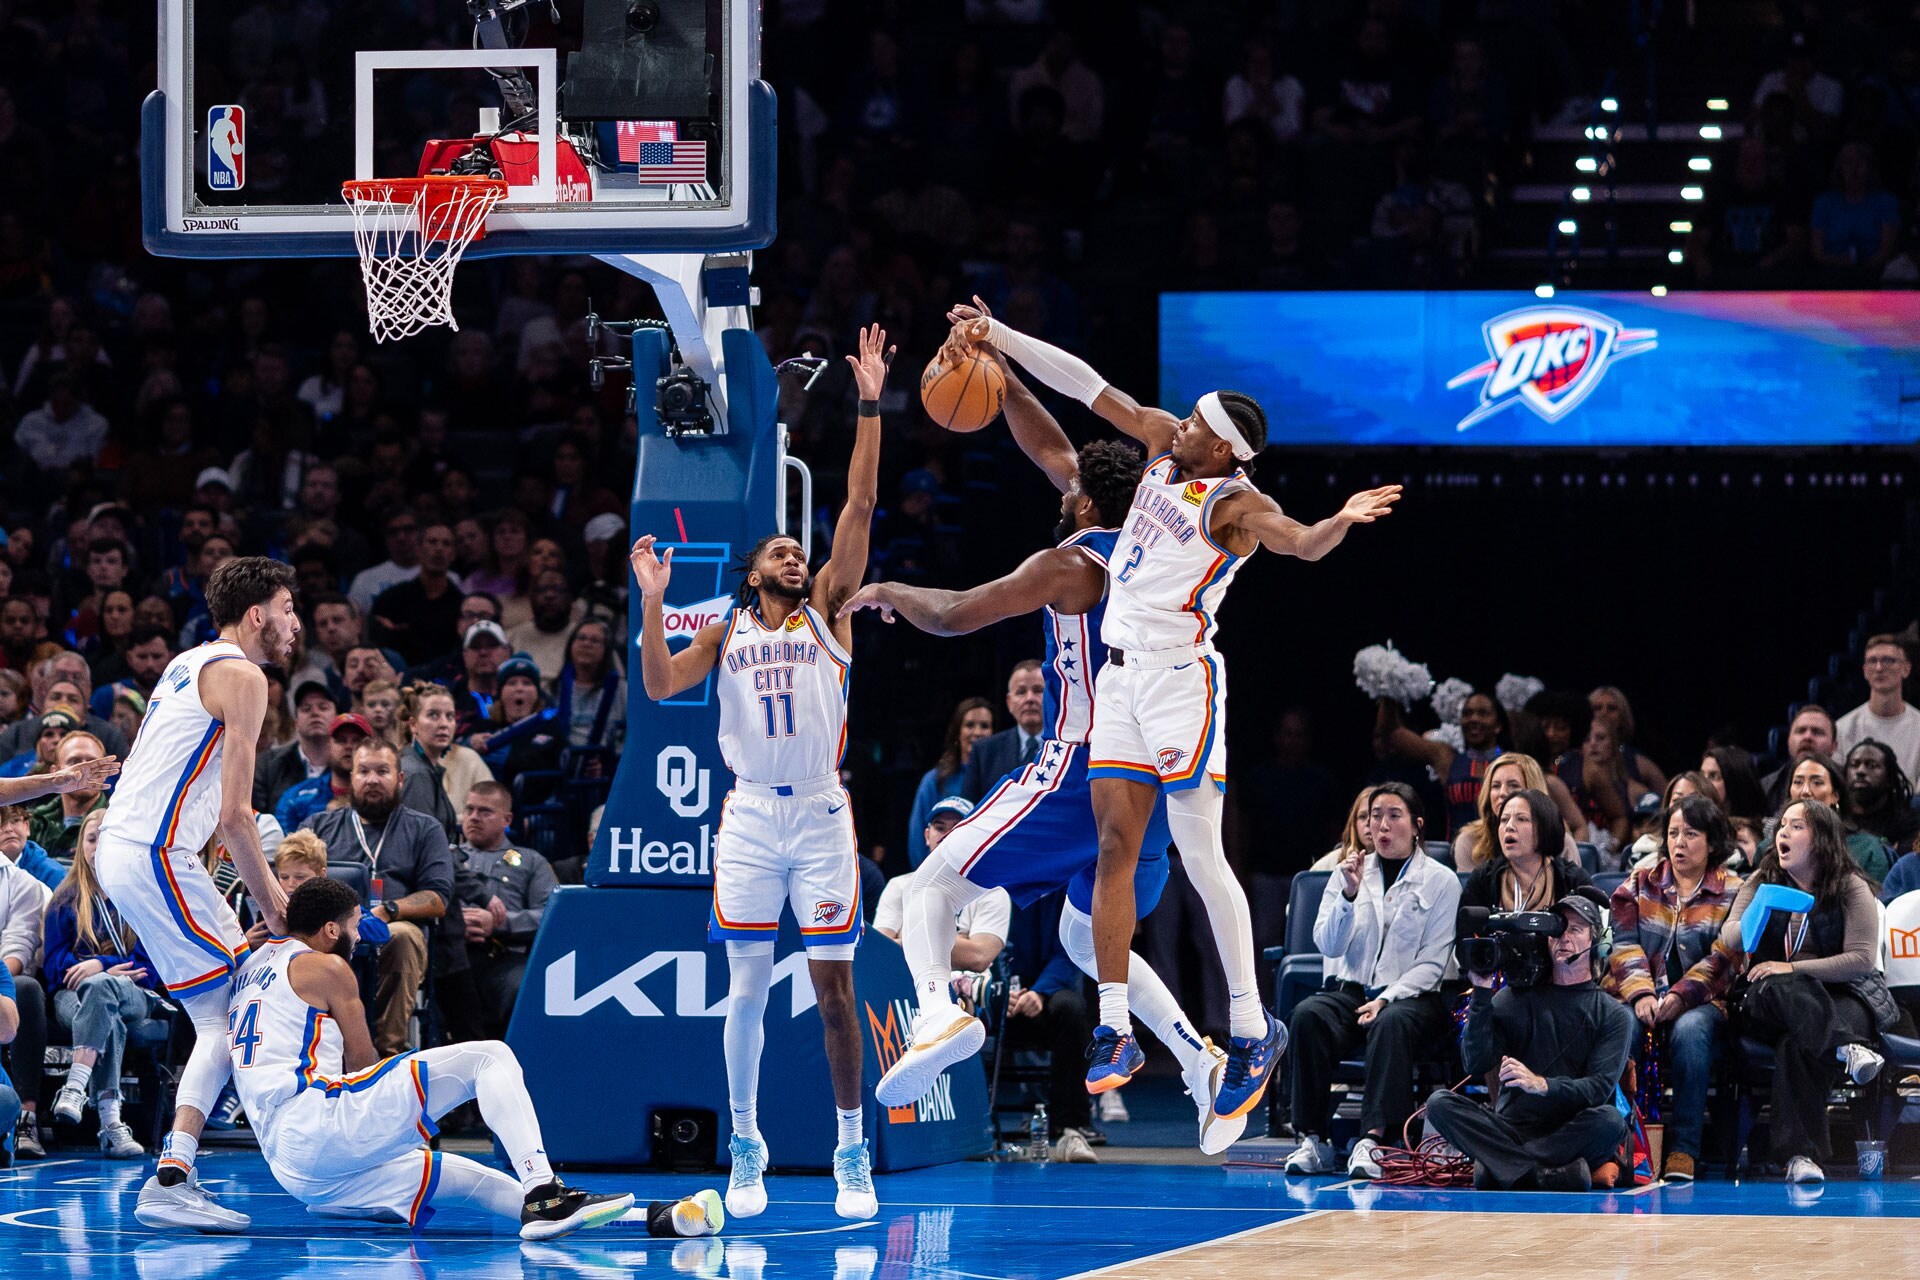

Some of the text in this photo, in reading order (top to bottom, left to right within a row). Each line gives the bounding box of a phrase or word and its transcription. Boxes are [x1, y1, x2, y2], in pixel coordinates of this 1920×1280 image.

[213, 171, 231, 185] NBA
[182, 218, 240, 232] SPALDING
[1487, 325, 1592, 398] OKC
[1131, 513, 1164, 549] CITY
[1133, 485, 1197, 546] KLAHOMA
[1114, 543, 1146, 587] 2
[662, 613, 719, 631] ONIC
[726, 641, 818, 674] OKLAHOMA
[753, 666, 794, 692] CITY
[759, 691, 796, 738] 11
[656, 745, 710, 817] OU
[608, 824, 719, 875] Heal
